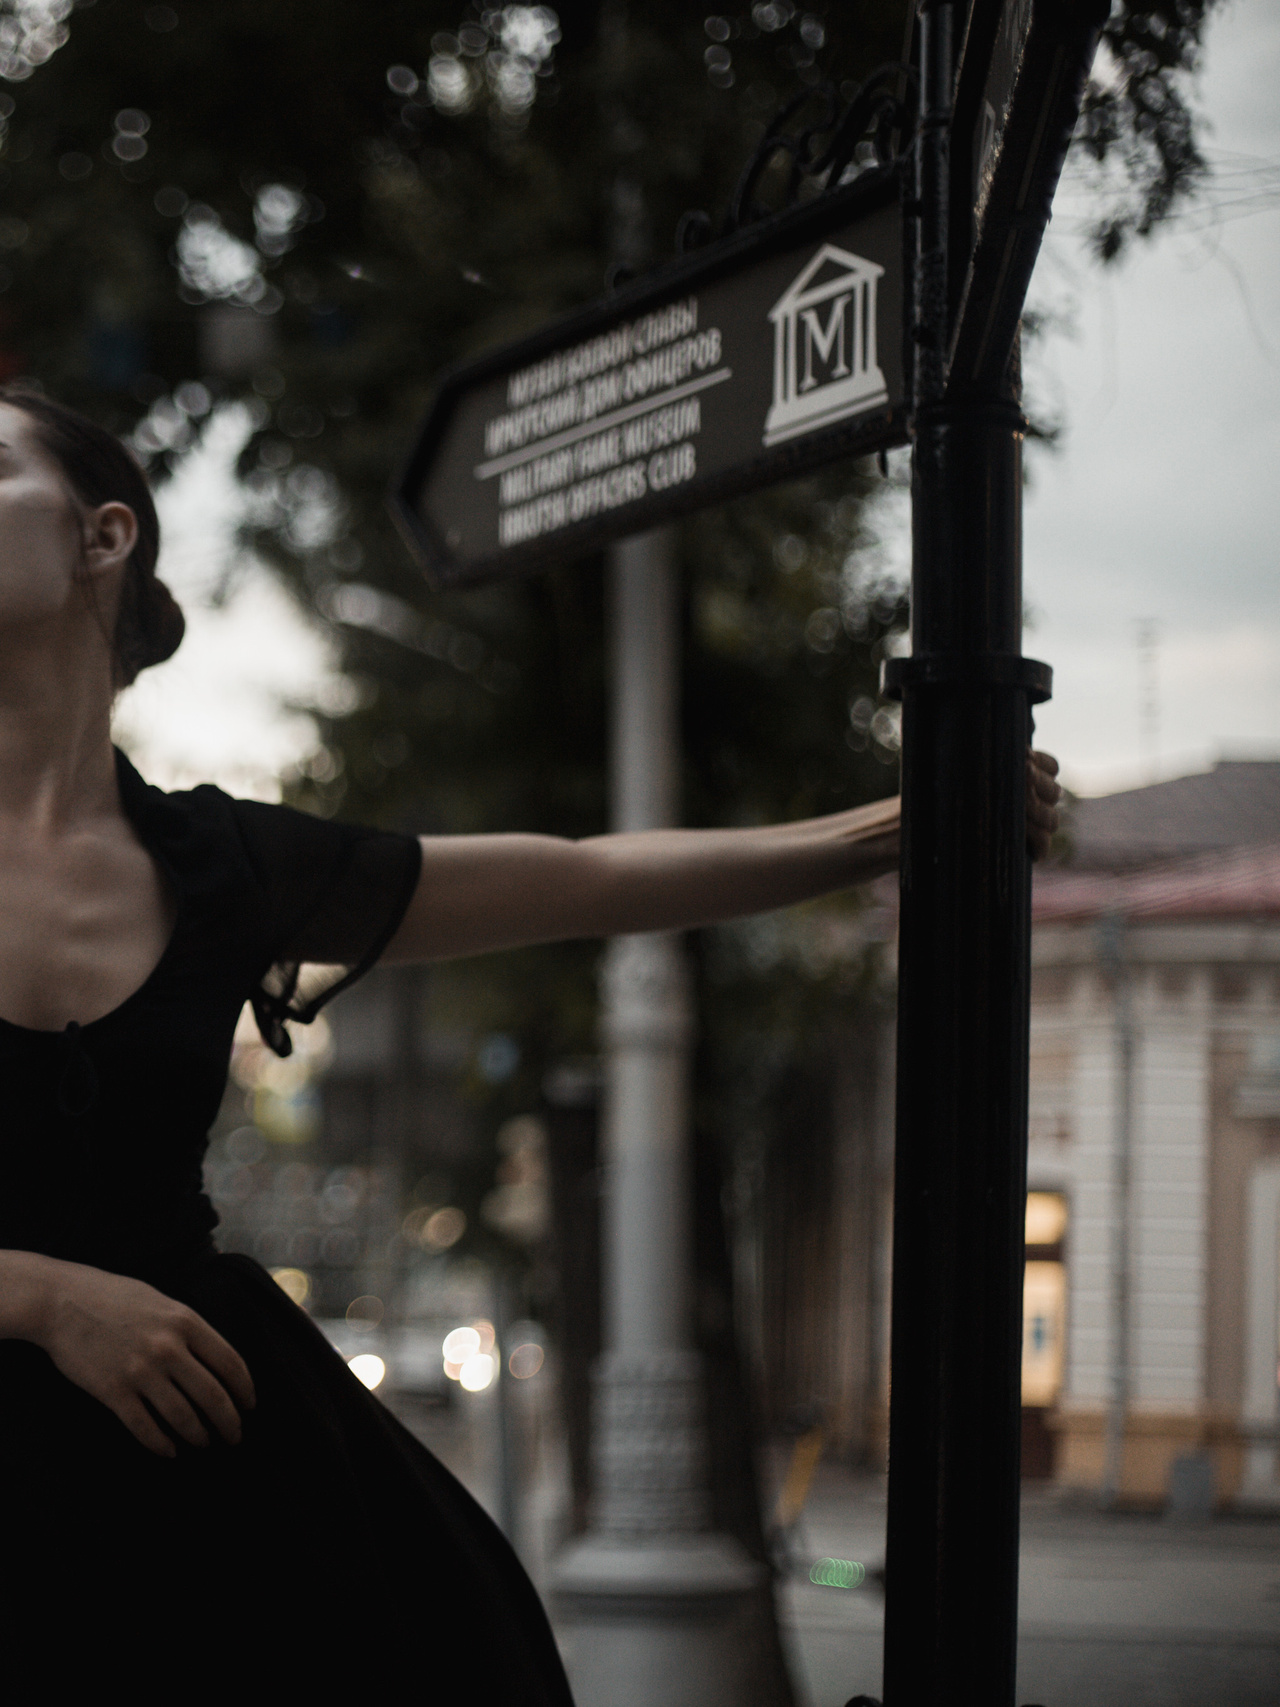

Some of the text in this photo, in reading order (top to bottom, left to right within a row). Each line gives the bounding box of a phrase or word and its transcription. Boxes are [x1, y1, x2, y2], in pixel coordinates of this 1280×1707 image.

[634, 298, 697, 352] СЛАВЫ
[582, 370, 621, 419] ДОМ
[623, 328, 722, 398] ОФИЦЕРОВ
[499, 449, 574, 505] MILITARY
[623, 398, 701, 457] MUSEUM
[649, 443, 696, 490] CLUB
